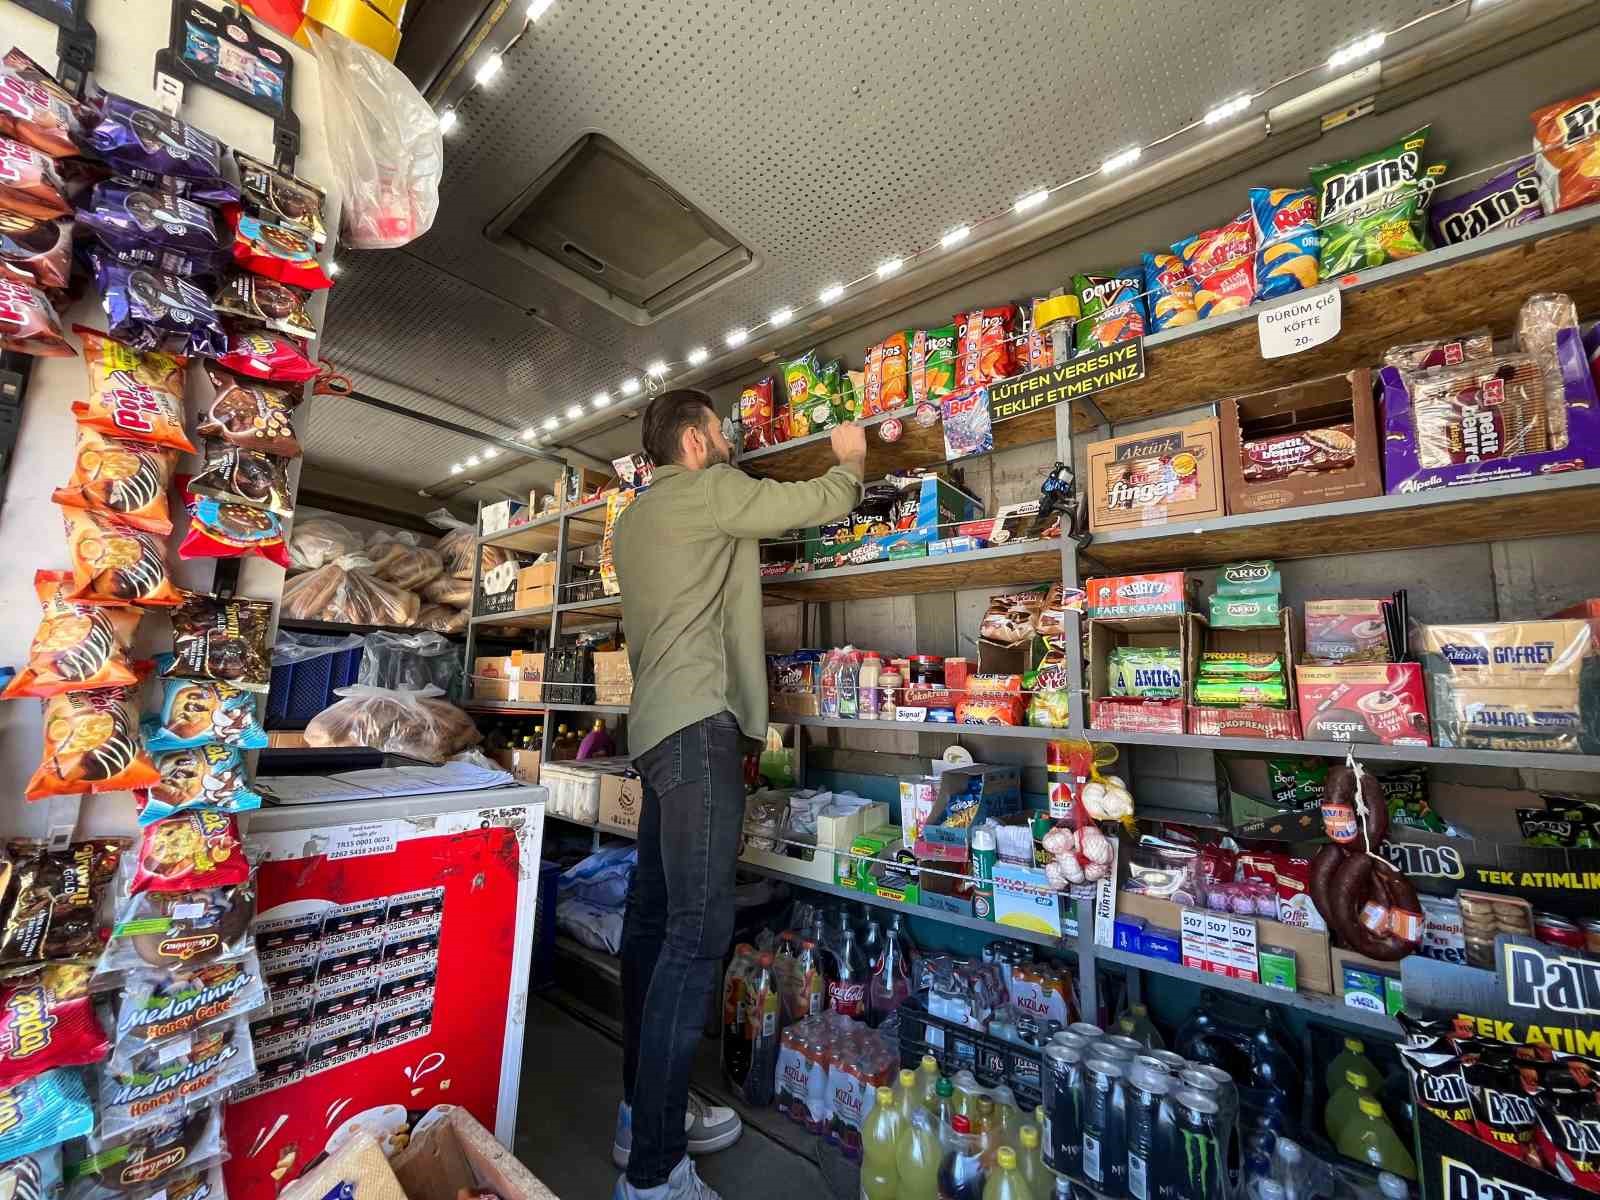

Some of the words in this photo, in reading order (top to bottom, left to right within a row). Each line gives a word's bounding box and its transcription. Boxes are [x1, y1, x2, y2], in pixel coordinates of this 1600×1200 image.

[1082, 277, 1140, 303] Doritos
[1266, 304, 1312, 324] DÜRÜM
[1284, 315, 1321, 334] KÖFTE
[992, 373, 1050, 402] LÜTFEN
[1053, 344, 1137, 382] VERESİYE
[993, 394, 1044, 417] TEKLİF
[1047, 364, 1138, 403] ETMEYİNİZ
[1120, 440, 1174, 460] Aktürk
[1401, 474, 1443, 494] Alpella
[1108, 480, 1179, 509] finger
[1228, 568, 1268, 579] ARKO
[1097, 606, 1128, 615] FARE
[1493, 645, 1554, 664] GOFRET
[1135, 669, 1181, 687] AMIGO
[898, 710, 921, 719] Signal
[62, 868, 76, 894] GOLD
[1478, 870, 1513, 885] TEK
[1183, 916, 1201, 928] 507
[1207, 920, 1226, 933] 507
[1232, 926, 1252, 938] 507
[1017, 997, 1050, 1015] KIZILAY
[147, 1014, 193, 1038] Honey
[195, 998, 232, 1023] Cake
[784, 1064, 809, 1087] KIZILAY
[129, 1090, 175, 1117] Honey
[179, 1075, 214, 1097] Cake
[835, 1088, 863, 1110] KIZILAY
